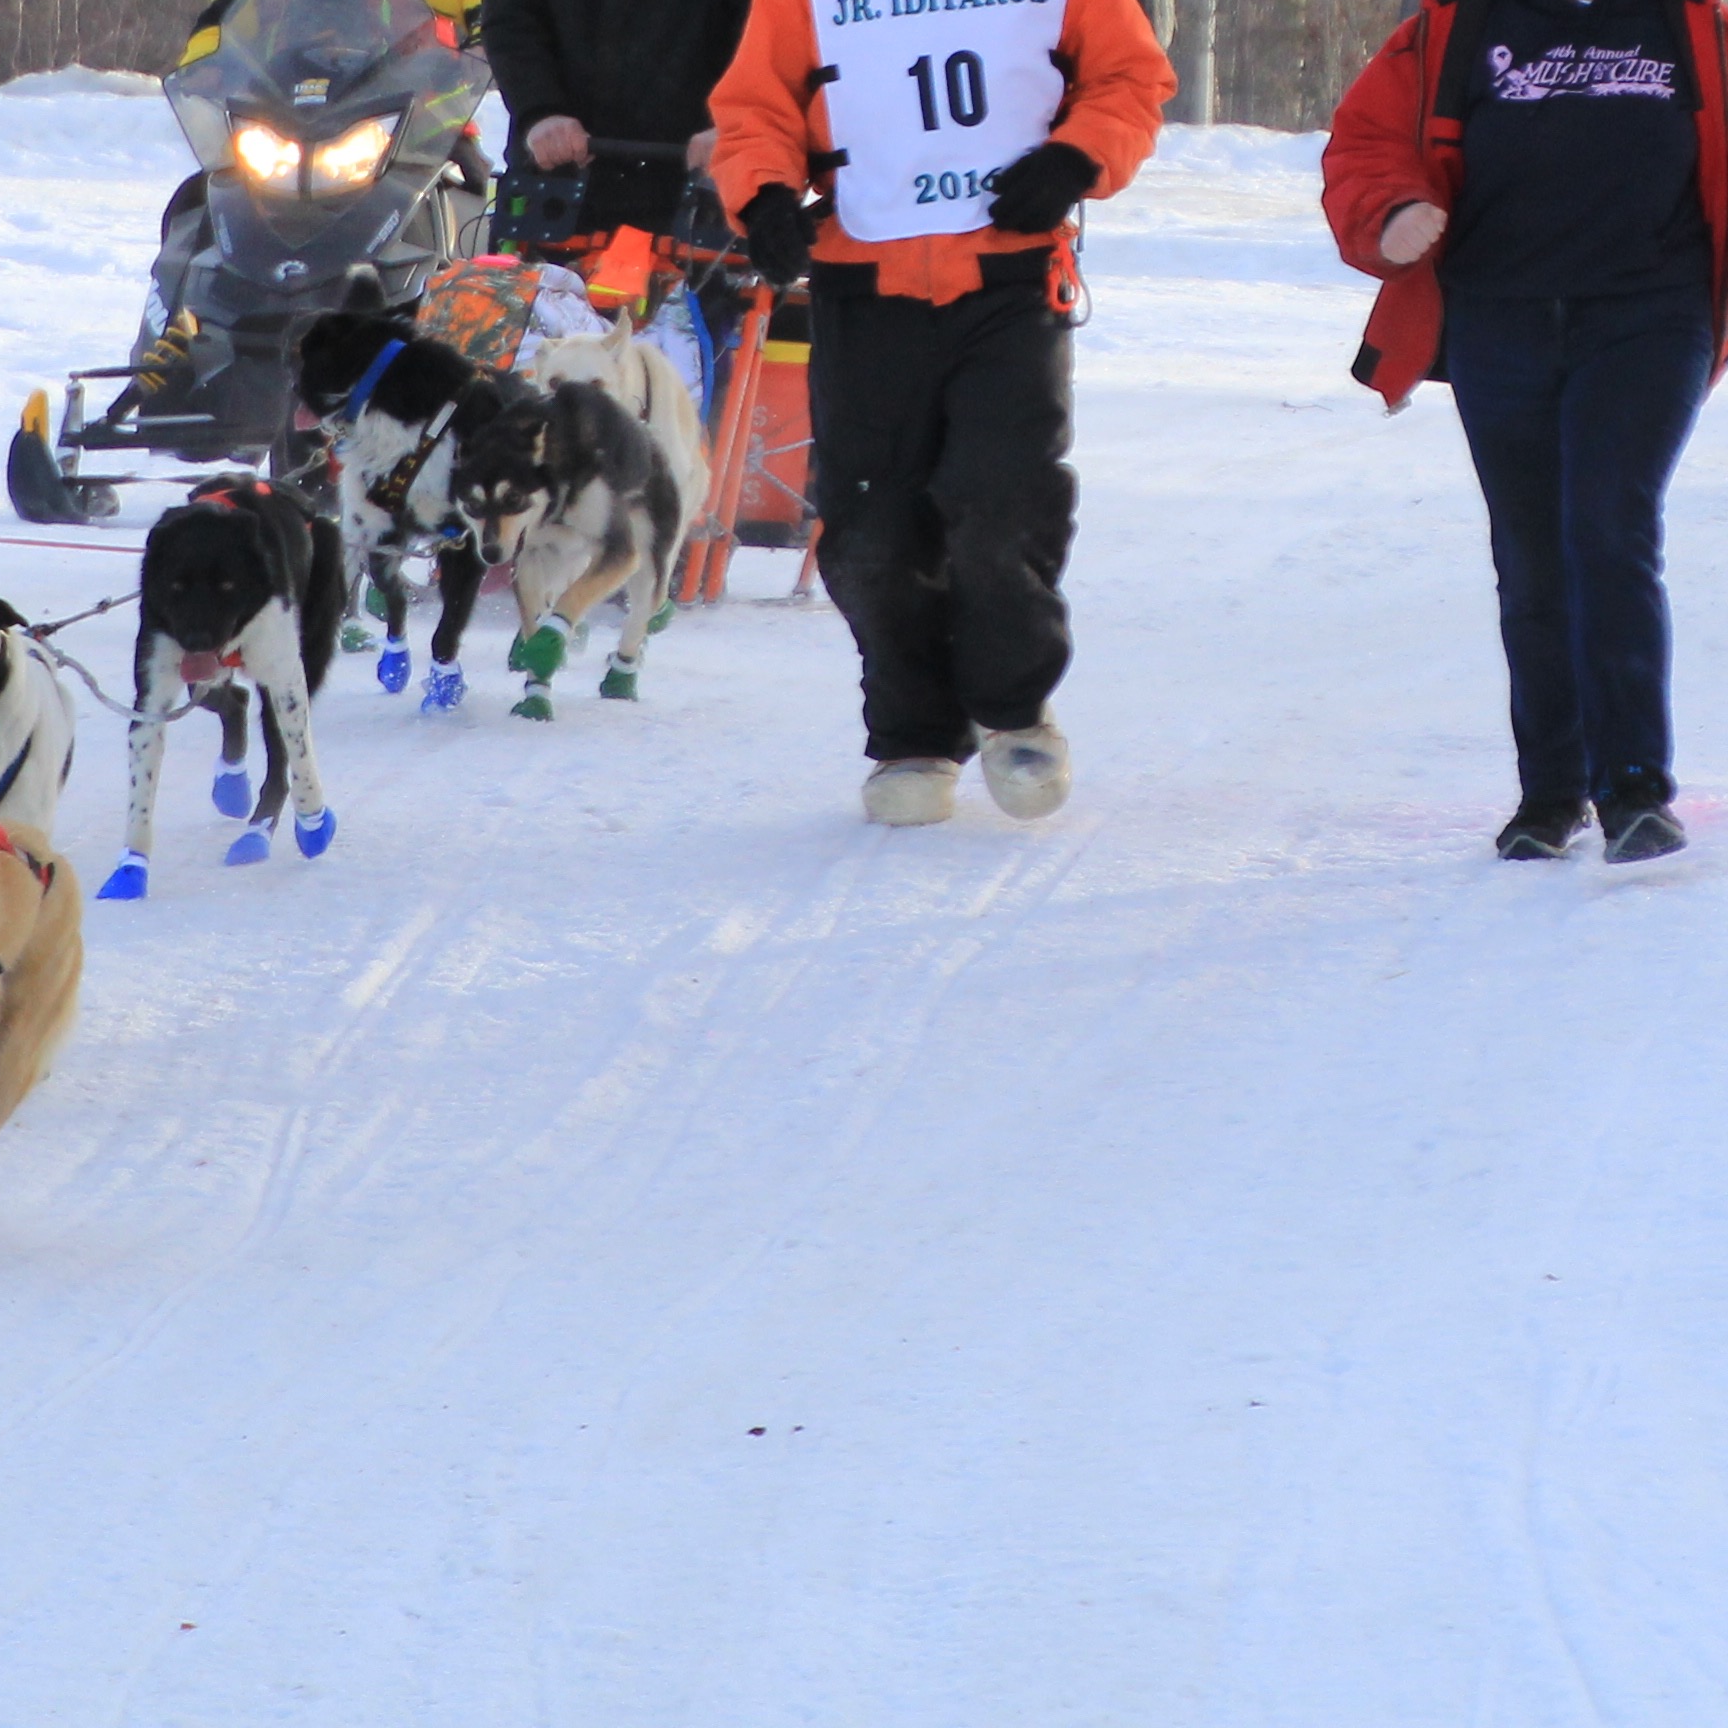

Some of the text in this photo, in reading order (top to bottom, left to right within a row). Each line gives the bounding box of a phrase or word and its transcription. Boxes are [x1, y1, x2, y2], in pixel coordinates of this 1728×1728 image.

[1583, 45, 1642, 60] Annual
[1523, 60, 1597, 86] MUSH
[1609, 58, 1676, 84] CURE
[908, 49, 990, 131] 10
